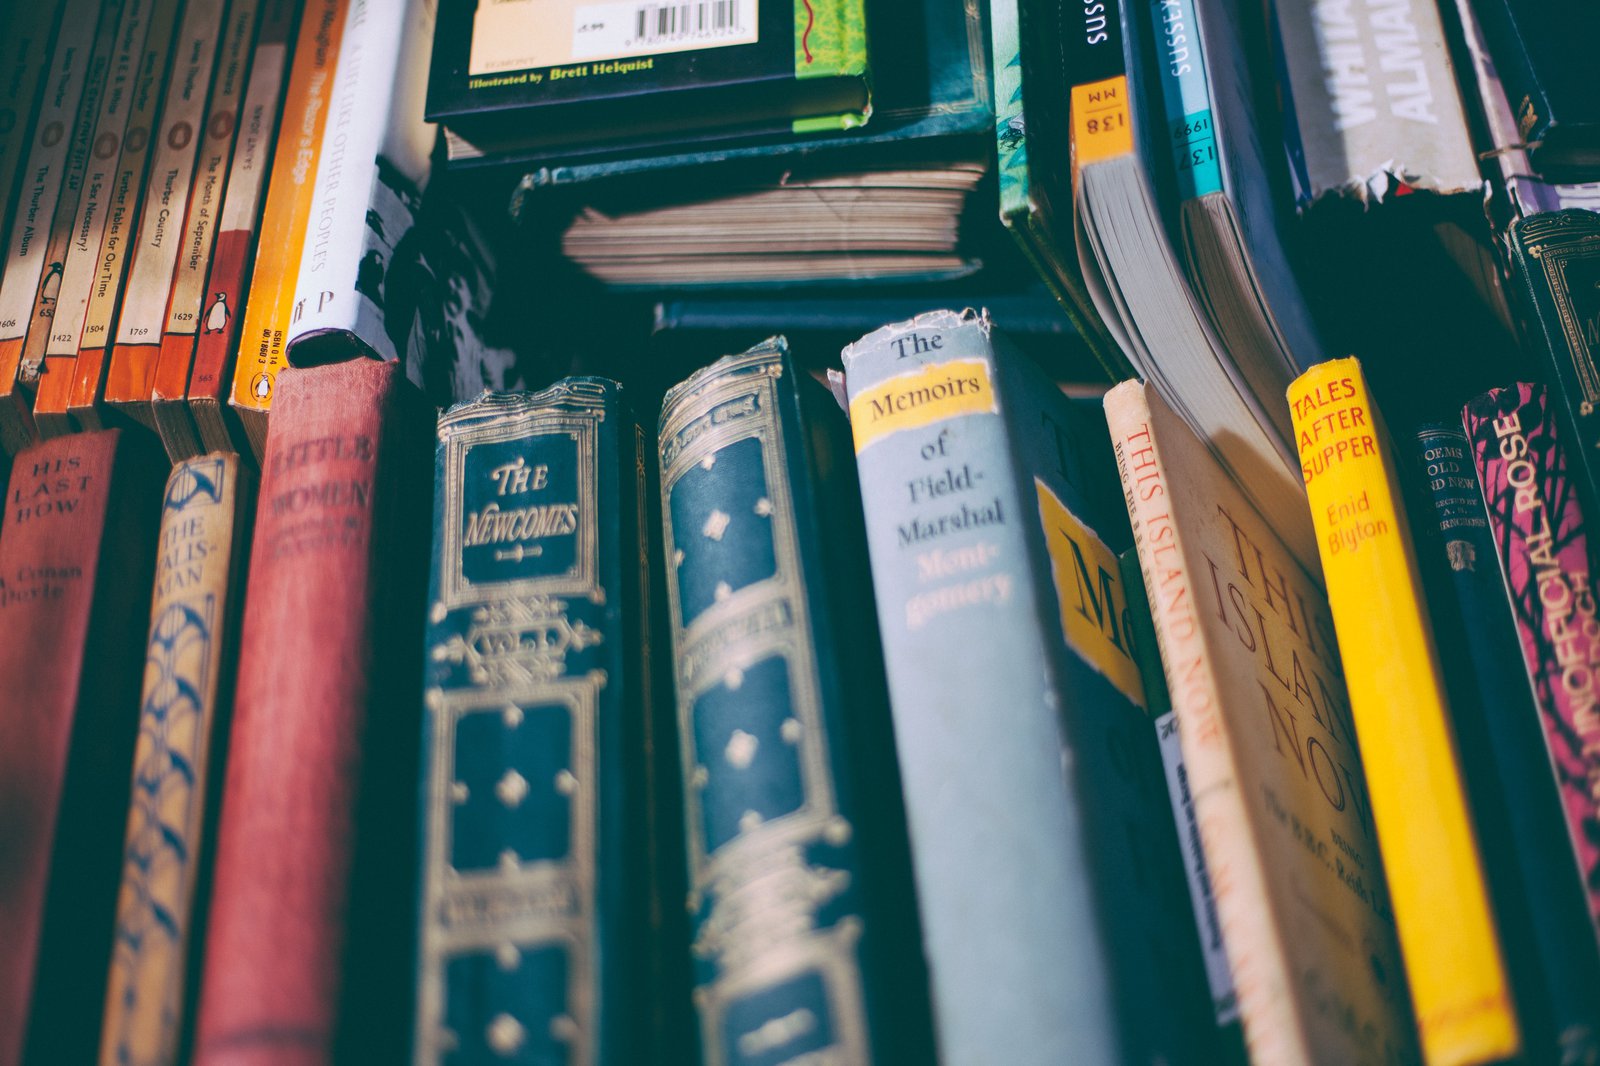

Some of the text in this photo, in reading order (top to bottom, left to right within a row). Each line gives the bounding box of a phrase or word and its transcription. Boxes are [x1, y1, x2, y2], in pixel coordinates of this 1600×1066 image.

[1082, 0, 1109, 44] SUS
[469, 58, 654, 89] Illustrated by Brett Helquist
[1364, 0, 1440, 125] ALMA
[335, 92, 359, 131] LIKE
[1086, 113, 1125, 135] 138
[1173, 119, 1209, 140] 1999
[292, 150, 314, 185] Edge
[322, 132, 349, 196] OTHER
[1178, 146, 1213, 170] 137
[19, 165, 49, 256] The Thurber Album
[76, 173, 105, 252] Is Sex Necessary?
[151, 168, 179, 248] Thurber Country
[190, 157, 222, 271] The Month of September
[97, 170, 133, 298] Further Fables for Our Time
[310, 198, 339, 274] PEOPLE'S
[173, 313, 193, 321] 1629
[317, 289, 335, 313] P
[52, 334, 72, 342] 1422
[85, 325, 105, 334] 1504
[129, 328, 149, 336] 1769
[272, 330, 282, 347] ISBN
[890, 331, 944, 361] The
[269, 356, 278, 365] 14
[869, 374, 982, 424] Memoirs
[1291, 377, 1357, 422] TALES
[920, 426, 958, 463] of
[1300, 405, 1367, 454] AFTER
[32, 456, 81, 478] HIS
[1301, 434, 1378, 485] SUPPER
[1424, 446, 1463, 462] OEMS
[1427, 461, 1460, 477] OLD
[1492, 412, 1543, 513] ROSE
[14, 476, 93, 504] LAST
[491, 455, 549, 496] THE
[906, 464, 986, 504] Field-
[1115, 441, 1129, 485] BEING
[1126, 488, 1138, 517] THE
[1448, 476, 1475, 491] NEW
[463, 501, 579, 547] NEWCOMES
[895, 498, 1007, 548] Marshal
[1325, 489, 1371, 528] Enid
[1126, 422, 1165, 502] THIS
[1146, 513, 1198, 643] ISLAND
[1327, 518, 1390, 556] Blyton
[162, 539, 218, 570] ALIS-
[904, 573, 1014, 630] gomery
[1201, 549, 1358, 760] ISLAN
